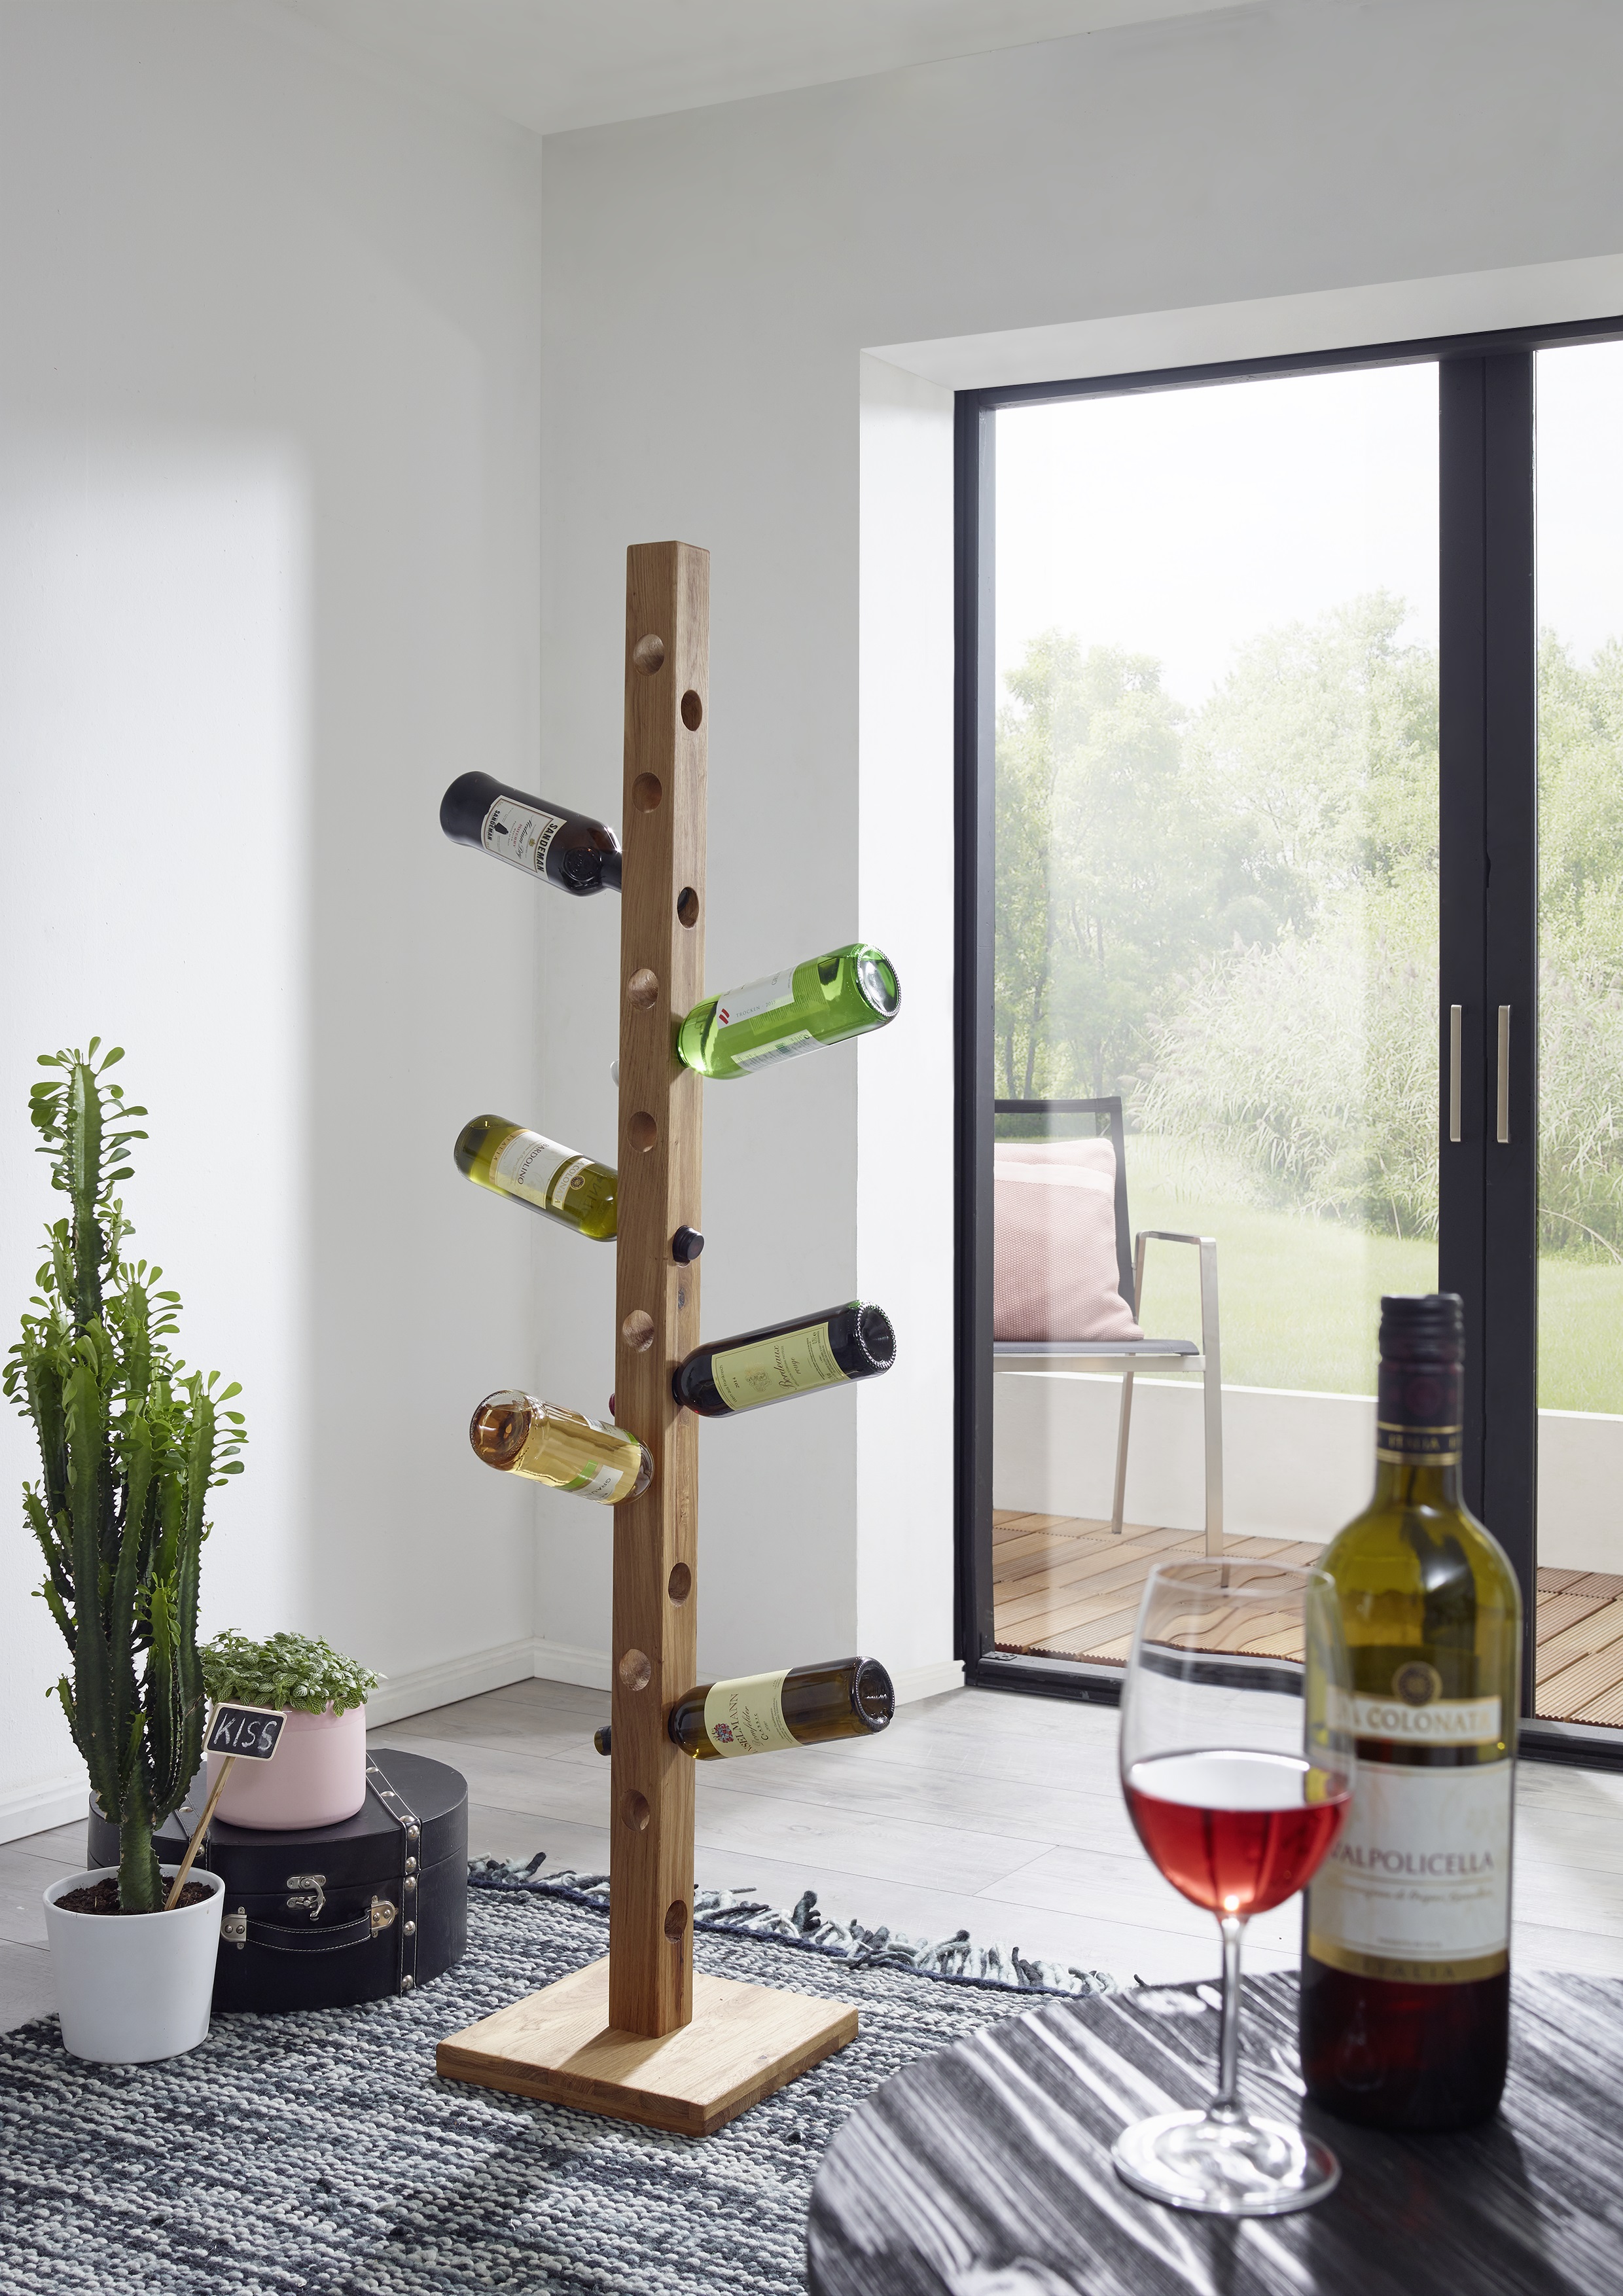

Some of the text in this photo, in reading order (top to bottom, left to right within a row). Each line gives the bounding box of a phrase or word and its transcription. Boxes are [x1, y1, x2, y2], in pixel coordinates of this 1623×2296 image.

[487, 810, 500, 841] SANDEMAN
[518, 816, 533, 843] Medium
[515, 844, 524, 859] Dry
[535, 823, 558, 872] SANDEMAN
[736, 1005, 760, 1018] TROCKEN
[493, 1134, 514, 1160] ITALIA
[517, 1143, 549, 1185] BARDOLINO
[555, 1165, 579, 1204] COLONATA
[774, 1346, 796, 1389] Bordeaux
[789, 1356, 801, 1374] rouge
[213, 1713, 277, 1751] KISS
[742, 1706, 764, 1746] Dornfelder
[1368, 1708, 1491, 1732] COLONATA
[1330, 1843, 1495, 1875] VALPOLICELLA
[1363, 1956, 1455, 1977] ITALIA
